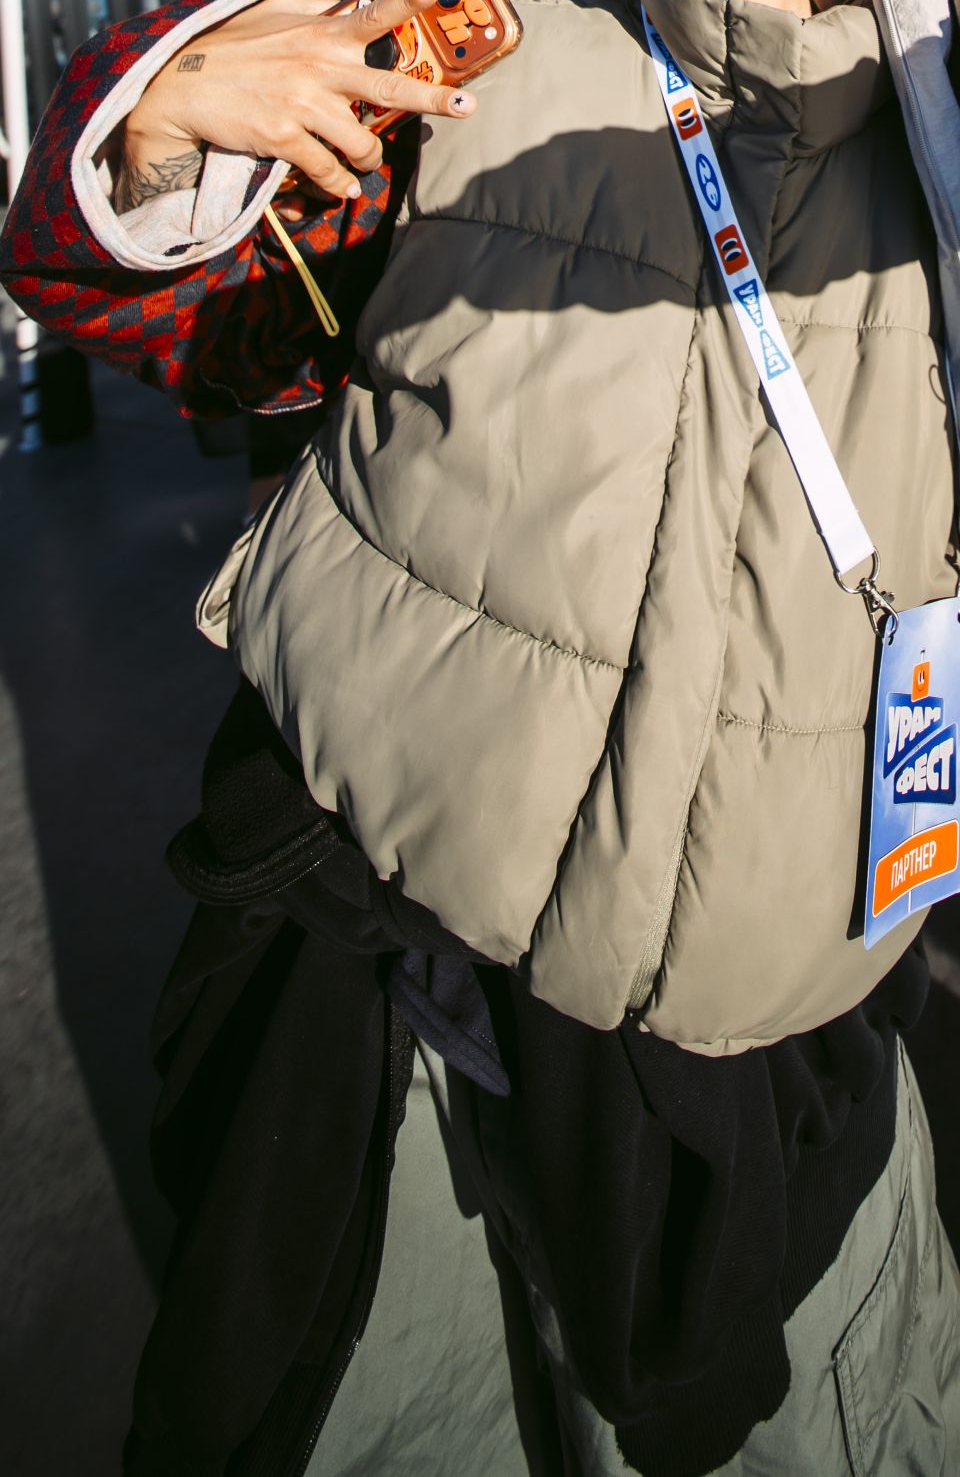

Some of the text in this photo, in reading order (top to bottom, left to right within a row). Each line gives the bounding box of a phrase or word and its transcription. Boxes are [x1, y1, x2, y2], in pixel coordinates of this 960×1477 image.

[698, 157, 719, 207] 26
[886, 706, 941, 763] УРАМ
[895, 737, 954, 795] ФЕСТ
[890, 839, 937, 891] ПАРТНЕР
